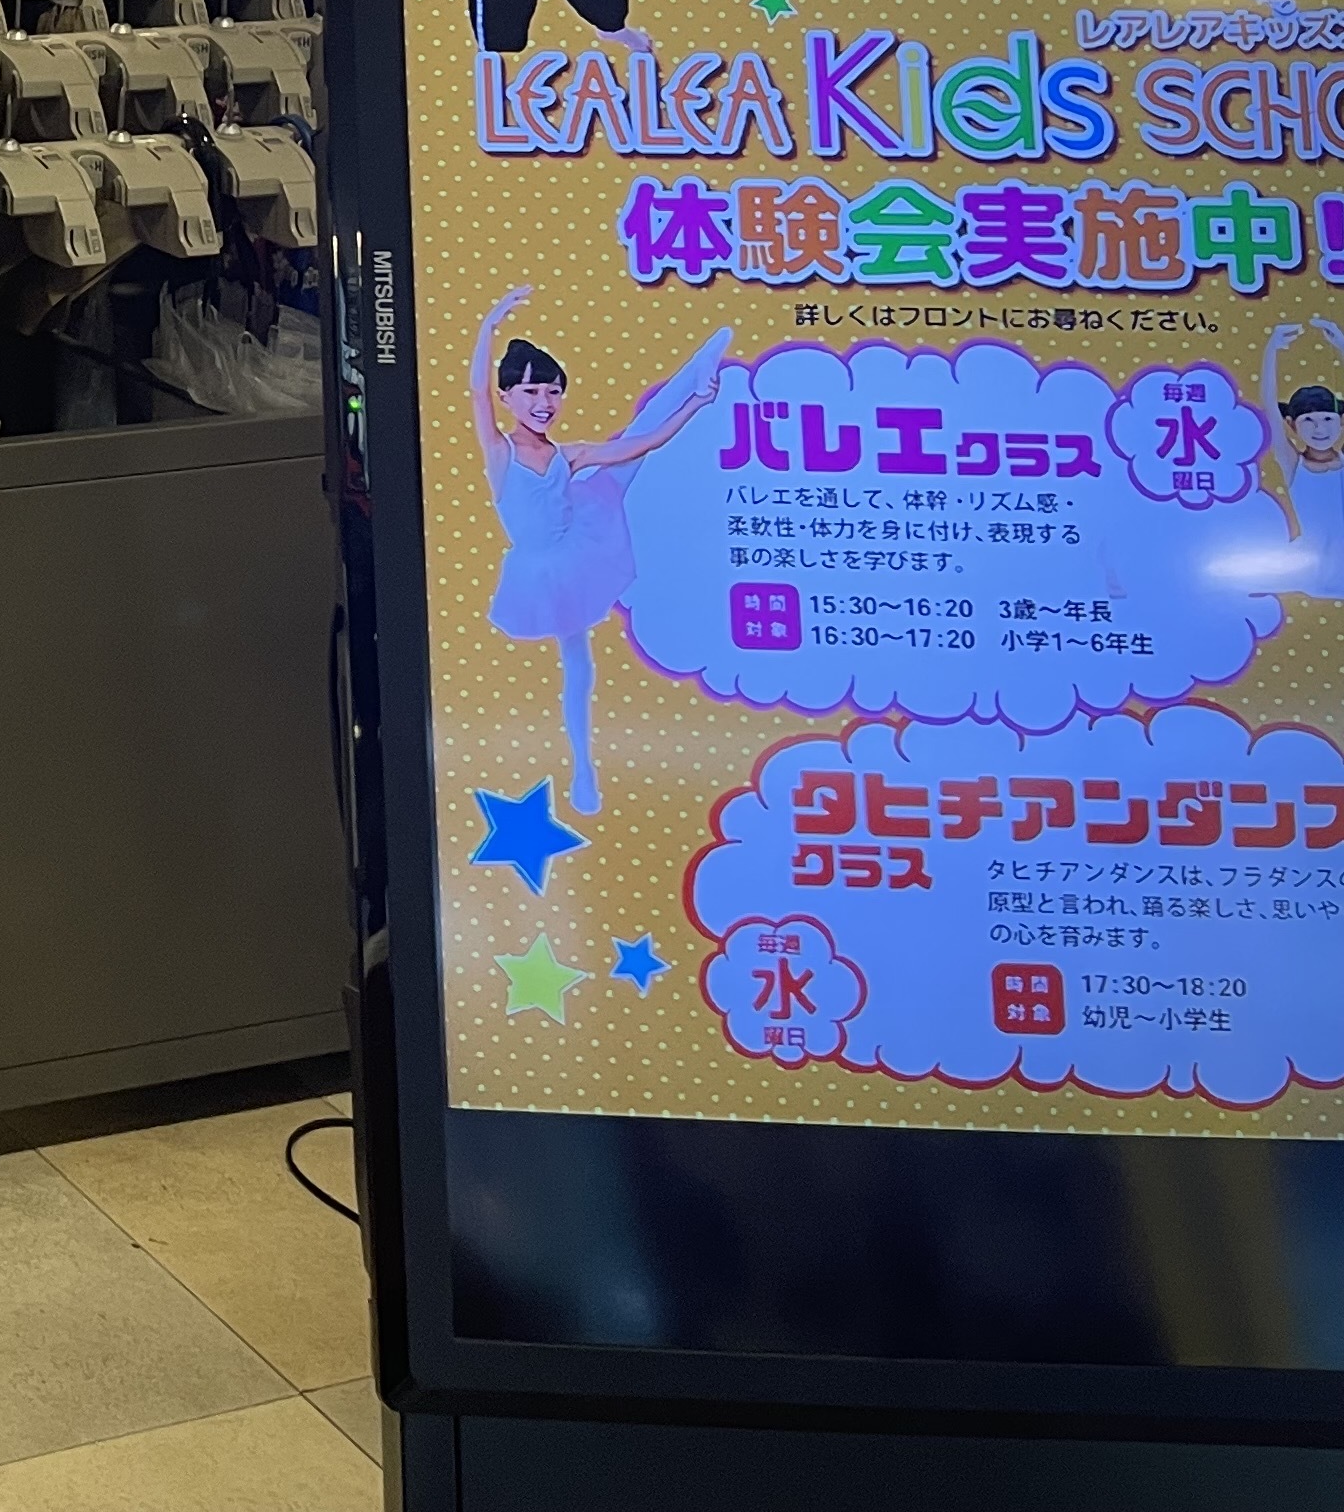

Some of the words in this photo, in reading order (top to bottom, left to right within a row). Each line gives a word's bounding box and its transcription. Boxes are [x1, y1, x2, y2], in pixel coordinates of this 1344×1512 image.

[479, 51, 791, 154] LEALEA
[807, 29, 1113, 157] Kids
[373, 250, 397, 365] MITSUBISHI
[793, 303, 1220, 334] 詳しくはフロントにお尋ねください。
[1162, 383, 1207, 404] 毎週
[719, 400, 1103, 478] バレエクラス
[1154, 406, 1223, 467] 水
[1171, 471, 1215, 492] 曜日
[726, 486, 1076, 514] バレエを通して、体幹・リズム感・
[728, 514, 1083, 546] 柔軟性・体力を身に付け、表現する
[729, 546, 965, 574] 事の楽しさを学びます。
[743, 593, 787, 614] 時間
[809, 595, 975, 620] 15:30～16:20
[998, 599, 1113, 624] 3歳～年長
[745, 620, 790, 640] 対象
[810, 625, 976, 651] 16:30～17:20
[1000, 630, 1155, 657] 小学1～6年生
[792, 844, 933, 890] クラス
[987, 859, 1344, 889] タヒチアンダンスは、フラダンス
[987, 891, 1341, 921] 原型と言われ、踊る楽しさ、思いや
[757, 934, 801, 956] 毎週
[989, 924, 1162, 951] の心を育みます。
[751, 958, 817, 1021] 水
[1080, 974, 1248, 999] 17:30～18:20
[1081, 1005, 1233, 1033] 幼児～小学生
[762, 1026, 805, 1048] 曜日
